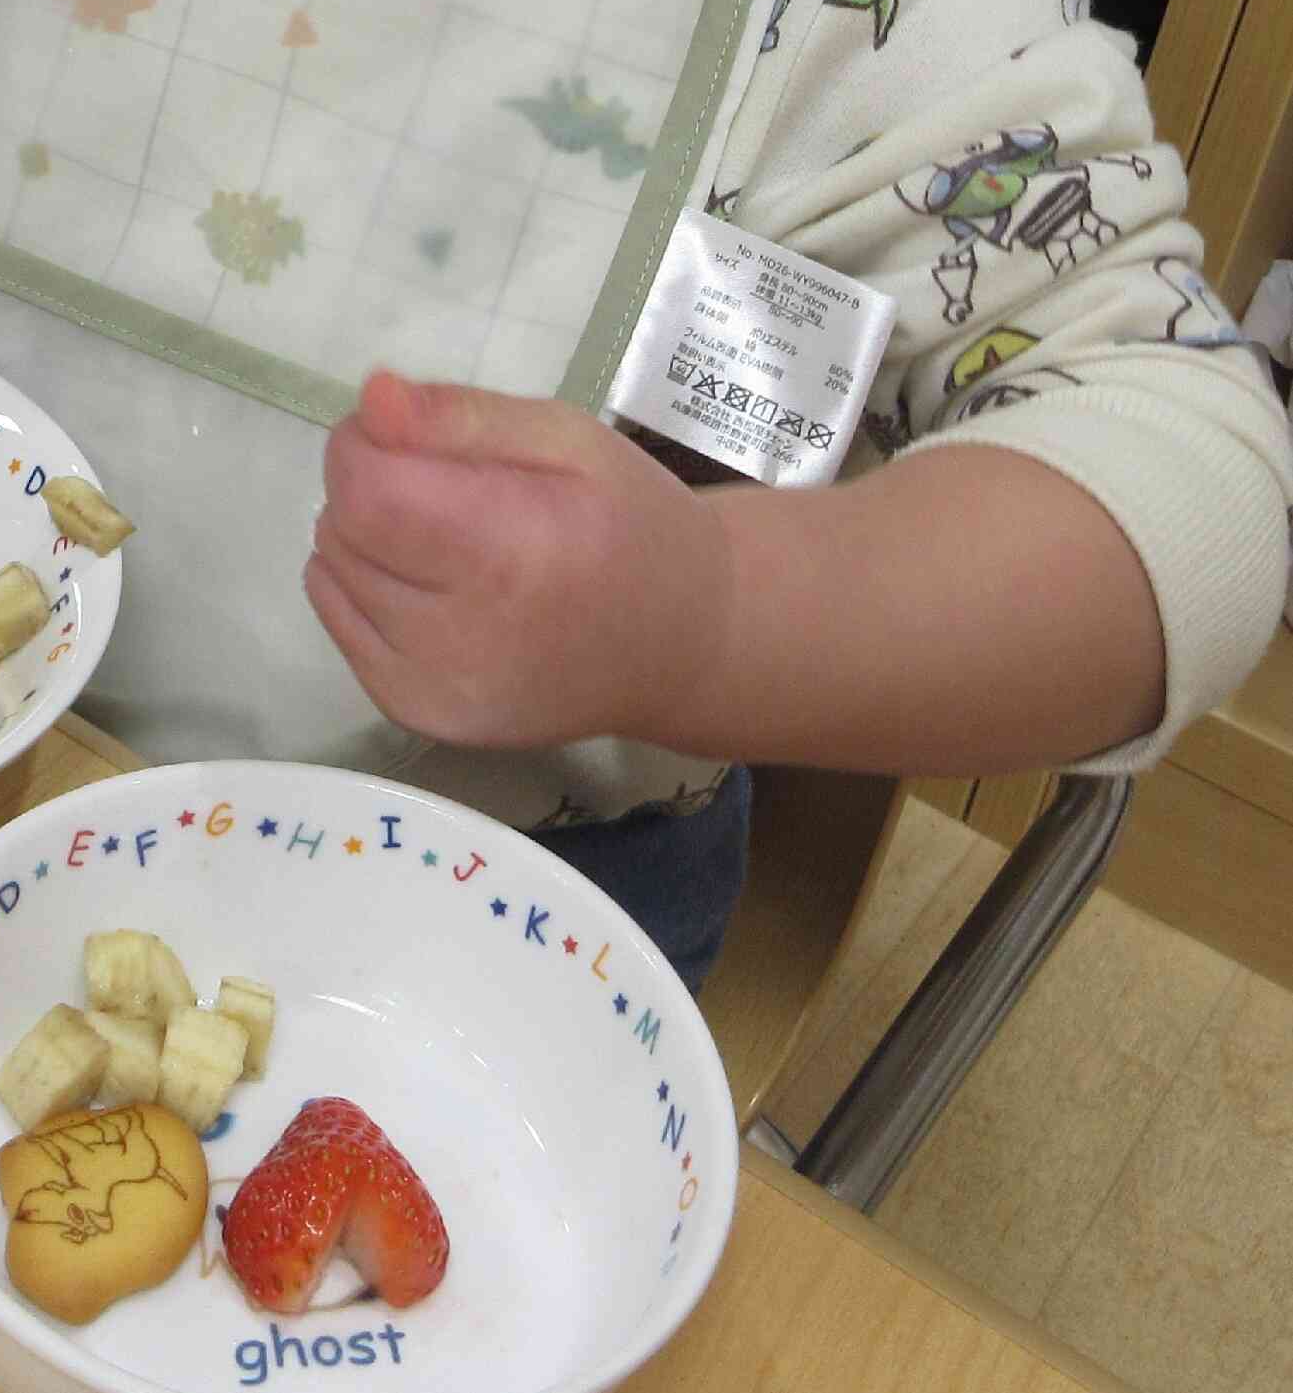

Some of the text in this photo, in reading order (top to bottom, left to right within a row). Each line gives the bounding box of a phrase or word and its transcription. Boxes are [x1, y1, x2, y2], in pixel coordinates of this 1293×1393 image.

[25, 466, 46, 496] D
[67, 830, 95, 867] E
[135, 829, 158, 867] F
[205, 802, 233, 837] G
[286, 822, 325, 860] H
[380, 816, 403, 850] I
[453, 852, 488, 882] J
[525, 905, 550, 946] K
[592, 943, 610, 982] L
[633, 1007, 661, 1056] M
[661, 1103, 687, 1152] N
[235, 1323, 406, 1386] ghost
